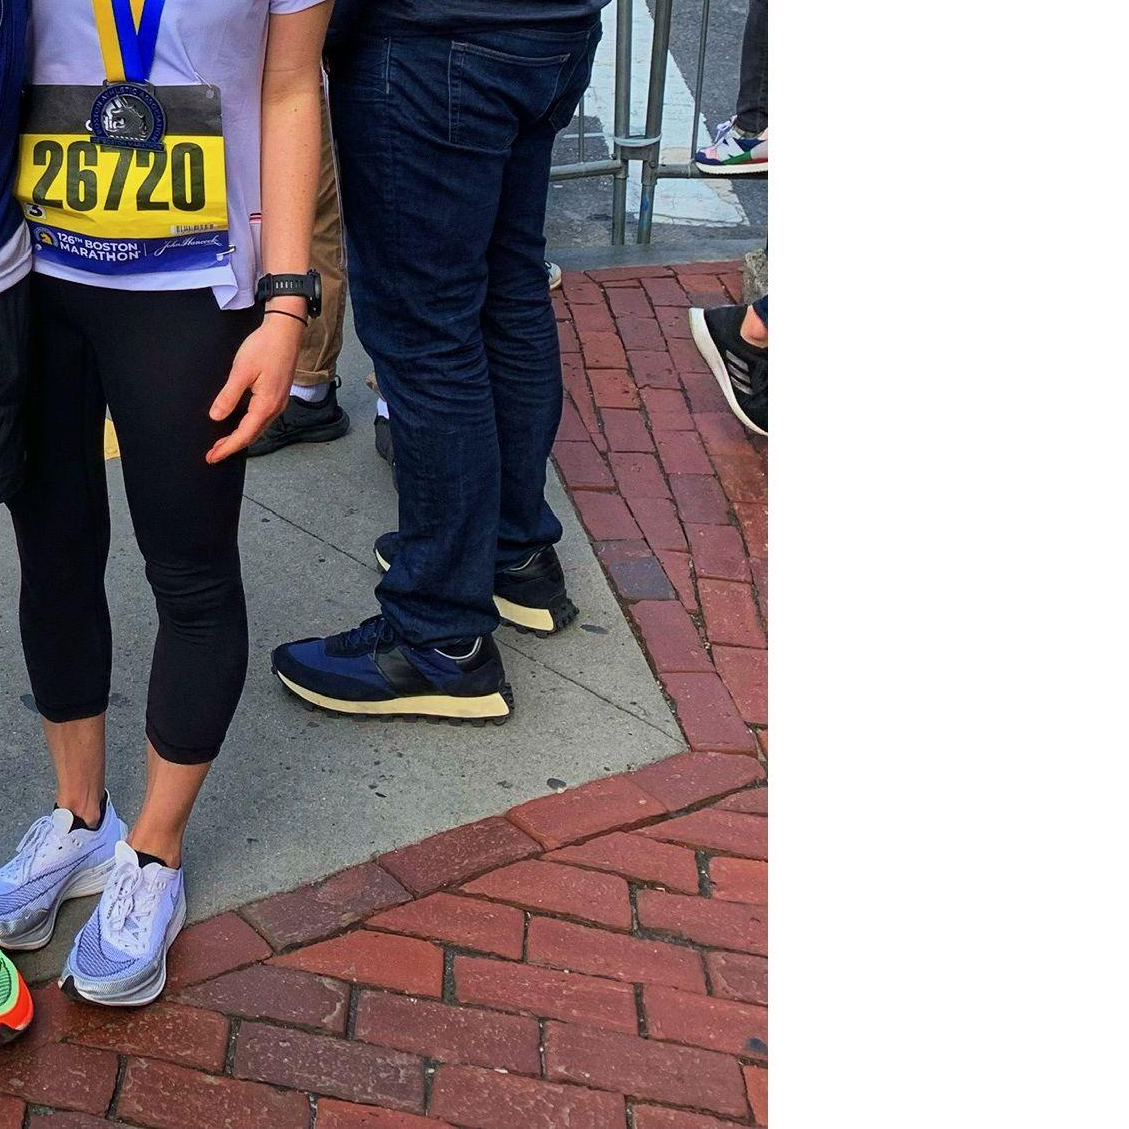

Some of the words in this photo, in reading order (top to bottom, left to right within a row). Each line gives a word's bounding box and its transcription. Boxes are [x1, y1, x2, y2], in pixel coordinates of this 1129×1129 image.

[31, 140, 207, 213] 26720
[57, 232, 84, 245] 126TH
[84, 239, 139, 252] BOSTON
[60, 241, 141, 262] MARATHON
